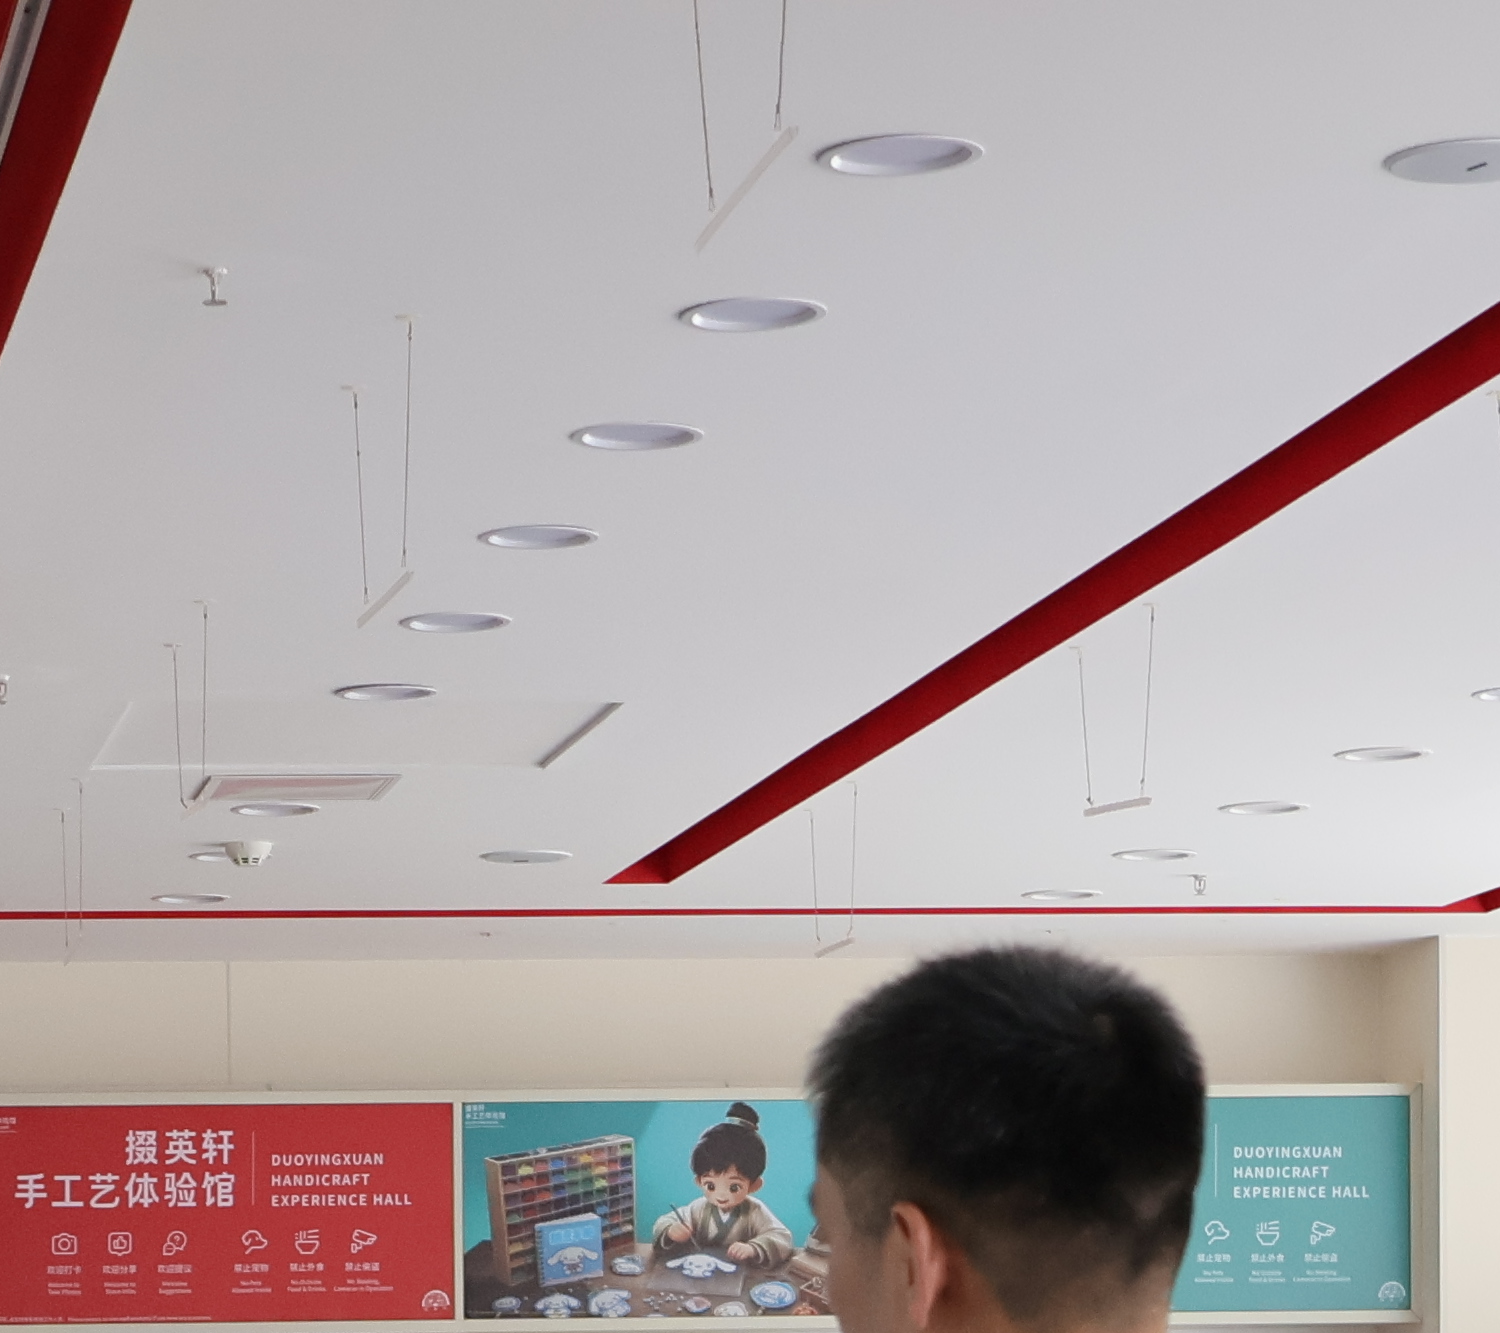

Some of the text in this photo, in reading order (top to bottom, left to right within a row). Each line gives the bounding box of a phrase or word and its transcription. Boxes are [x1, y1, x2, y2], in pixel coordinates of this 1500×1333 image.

[125, 1129, 235, 1166] 掇英轩
[1233, 1146, 1343, 1159] DUOYINGXUAN
[271, 1152, 384, 1167] DUOYINGXUAN
[1233, 1165, 1330, 1179] HANDICRAFT
[271, 1173, 370, 1188] HANDICRAFT
[14, 1172, 236, 1210] 手工艺体验馆
[1233, 1185, 1370, 1199] EXPERIENCE HALL
[271, 1191, 412, 1208] EXPERIENCE HALL
